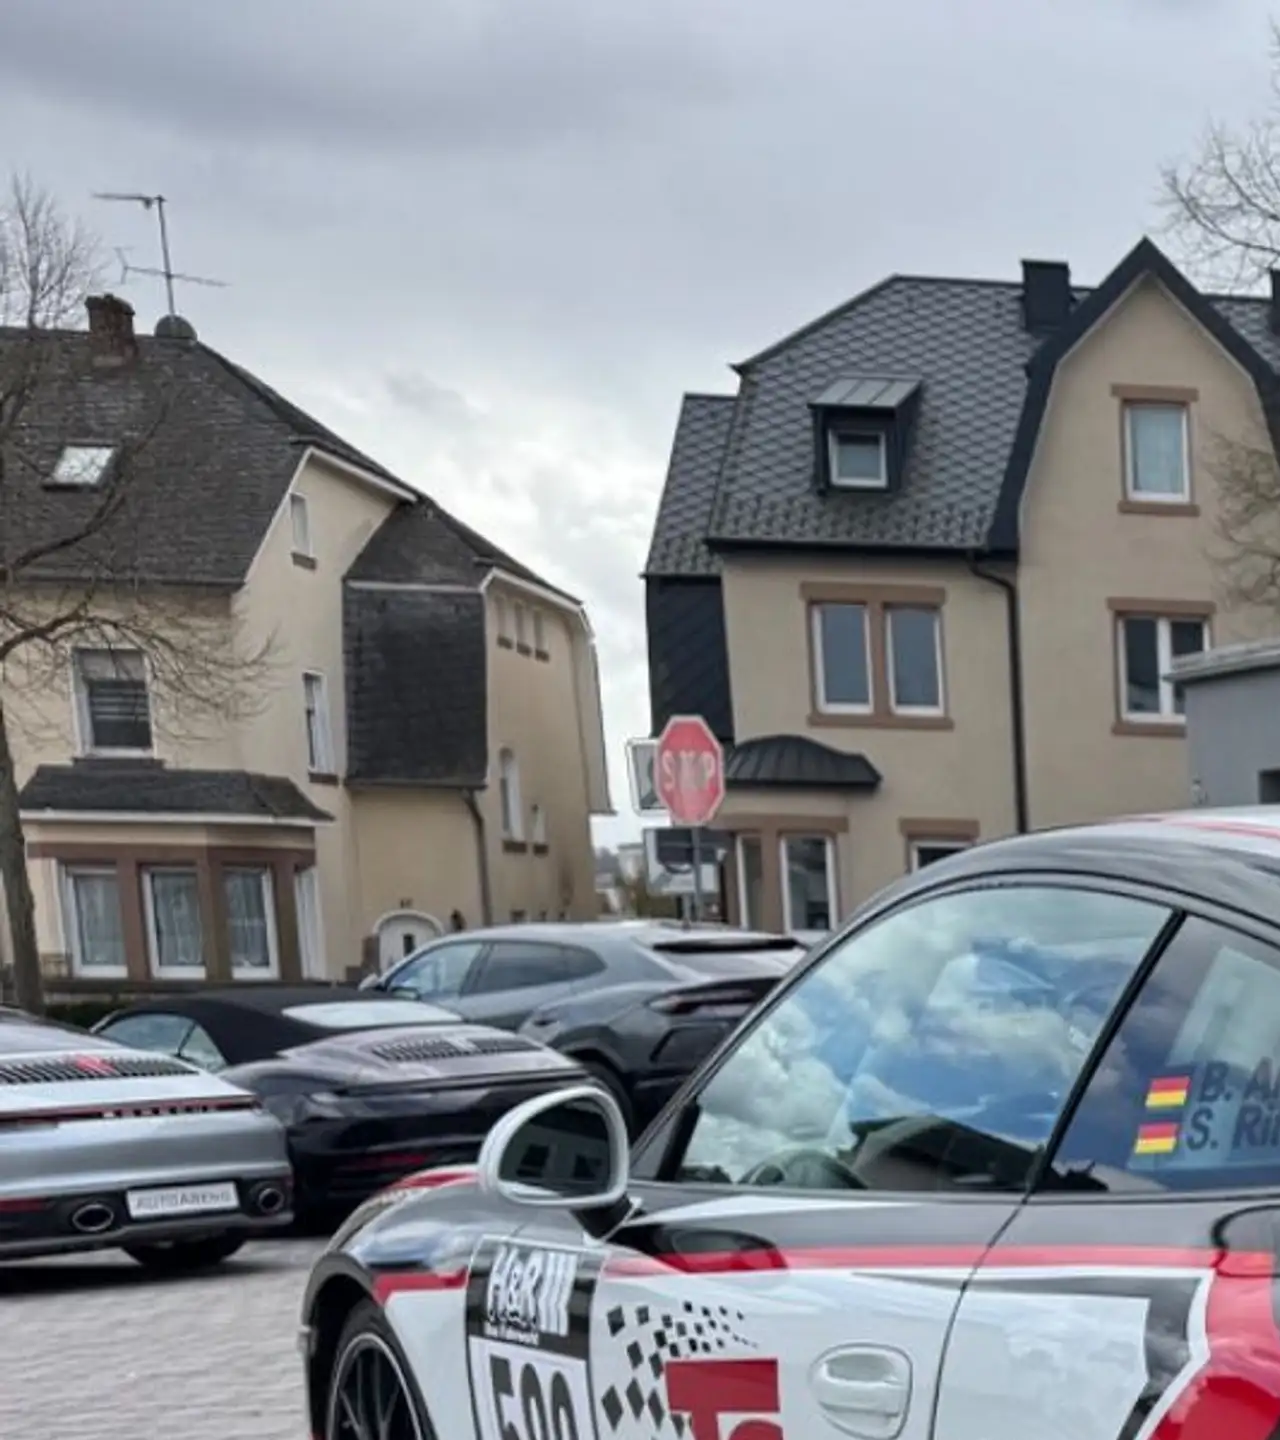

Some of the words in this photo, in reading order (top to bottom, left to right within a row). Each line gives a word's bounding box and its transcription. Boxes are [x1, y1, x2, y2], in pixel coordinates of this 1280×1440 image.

[662, 750, 715, 792] STOP
[1201, 1061, 1232, 1101] B.
[1186, 1107, 1218, 1151] S.
